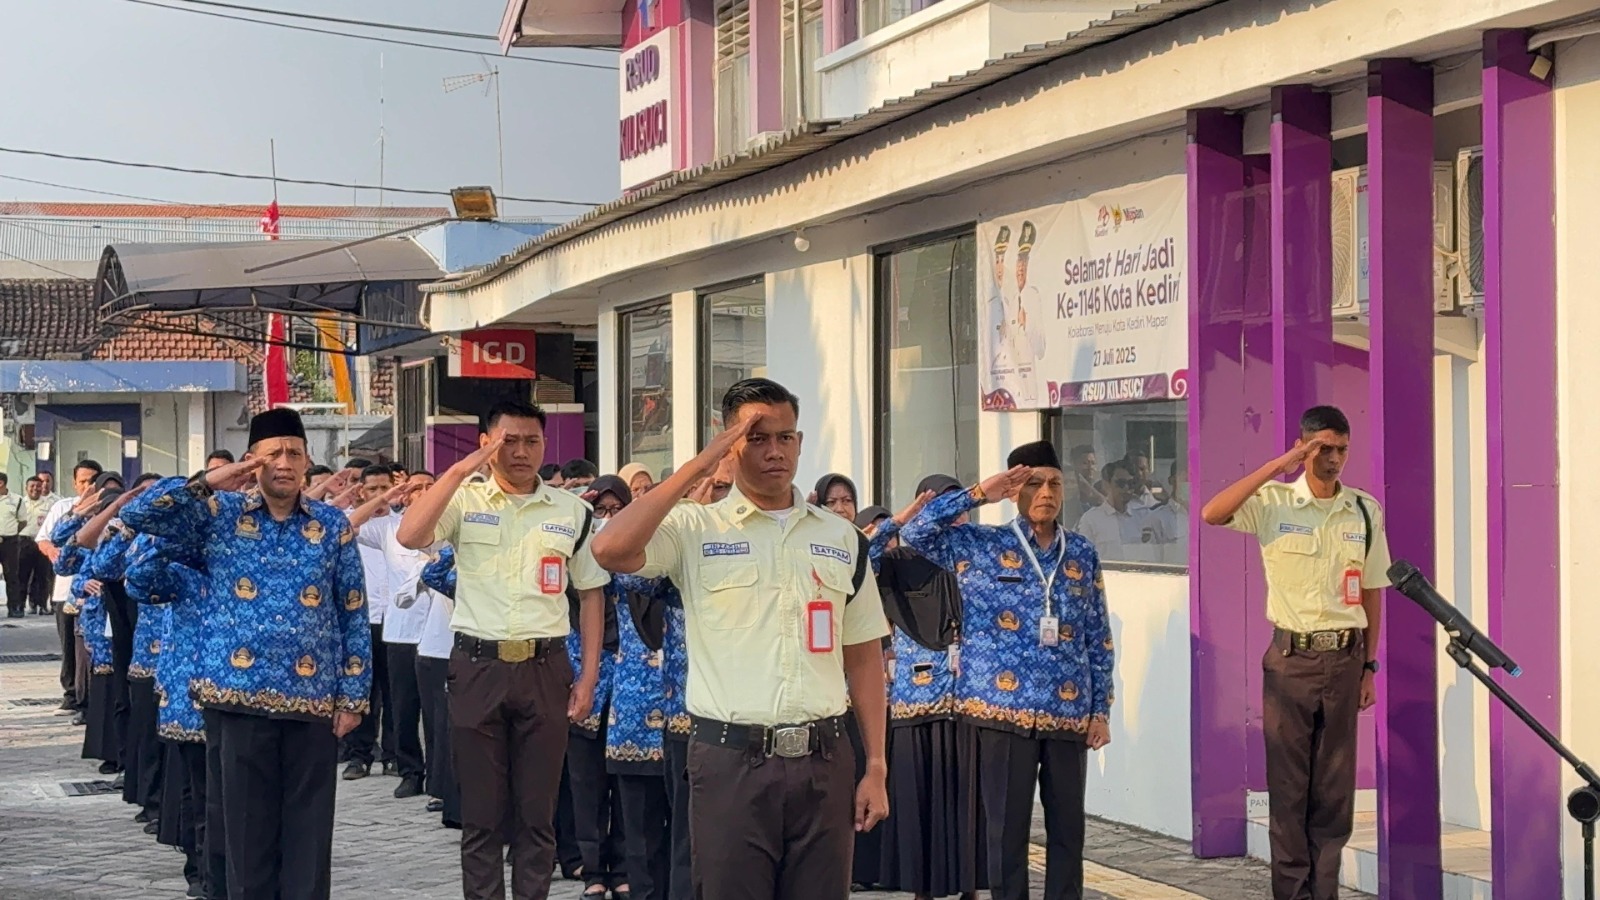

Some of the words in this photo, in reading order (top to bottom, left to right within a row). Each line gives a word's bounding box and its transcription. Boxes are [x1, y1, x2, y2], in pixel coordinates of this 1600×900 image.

[625, 45, 660, 92] RSUD
[620, 99, 667, 161] KILISUCI
[1064, 252, 1111, 286] Selamat
[1114, 244, 1142, 277] Hari
[1142, 237, 1174, 272] Jadi
[1057, 286, 1100, 319] Ke-1146
[1104, 283, 1132, 312] Kota
[1137, 272, 1181, 306] Kediri
[1112, 321, 1126, 334] Kota
[1146, 315, 1168, 330] Mapan
[472, 341, 526, 364] IGD
[1093, 350, 1101, 367] 27
[1102, 348, 1114, 366] Juli
[1115, 346, 1136, 364] 2025
[1081, 380, 1105, 402] RSUD
[1106, 377, 1144, 400] KILISUCI
[545, 524, 573, 535] SATPAM
[814, 546, 849, 561] SATPAM
